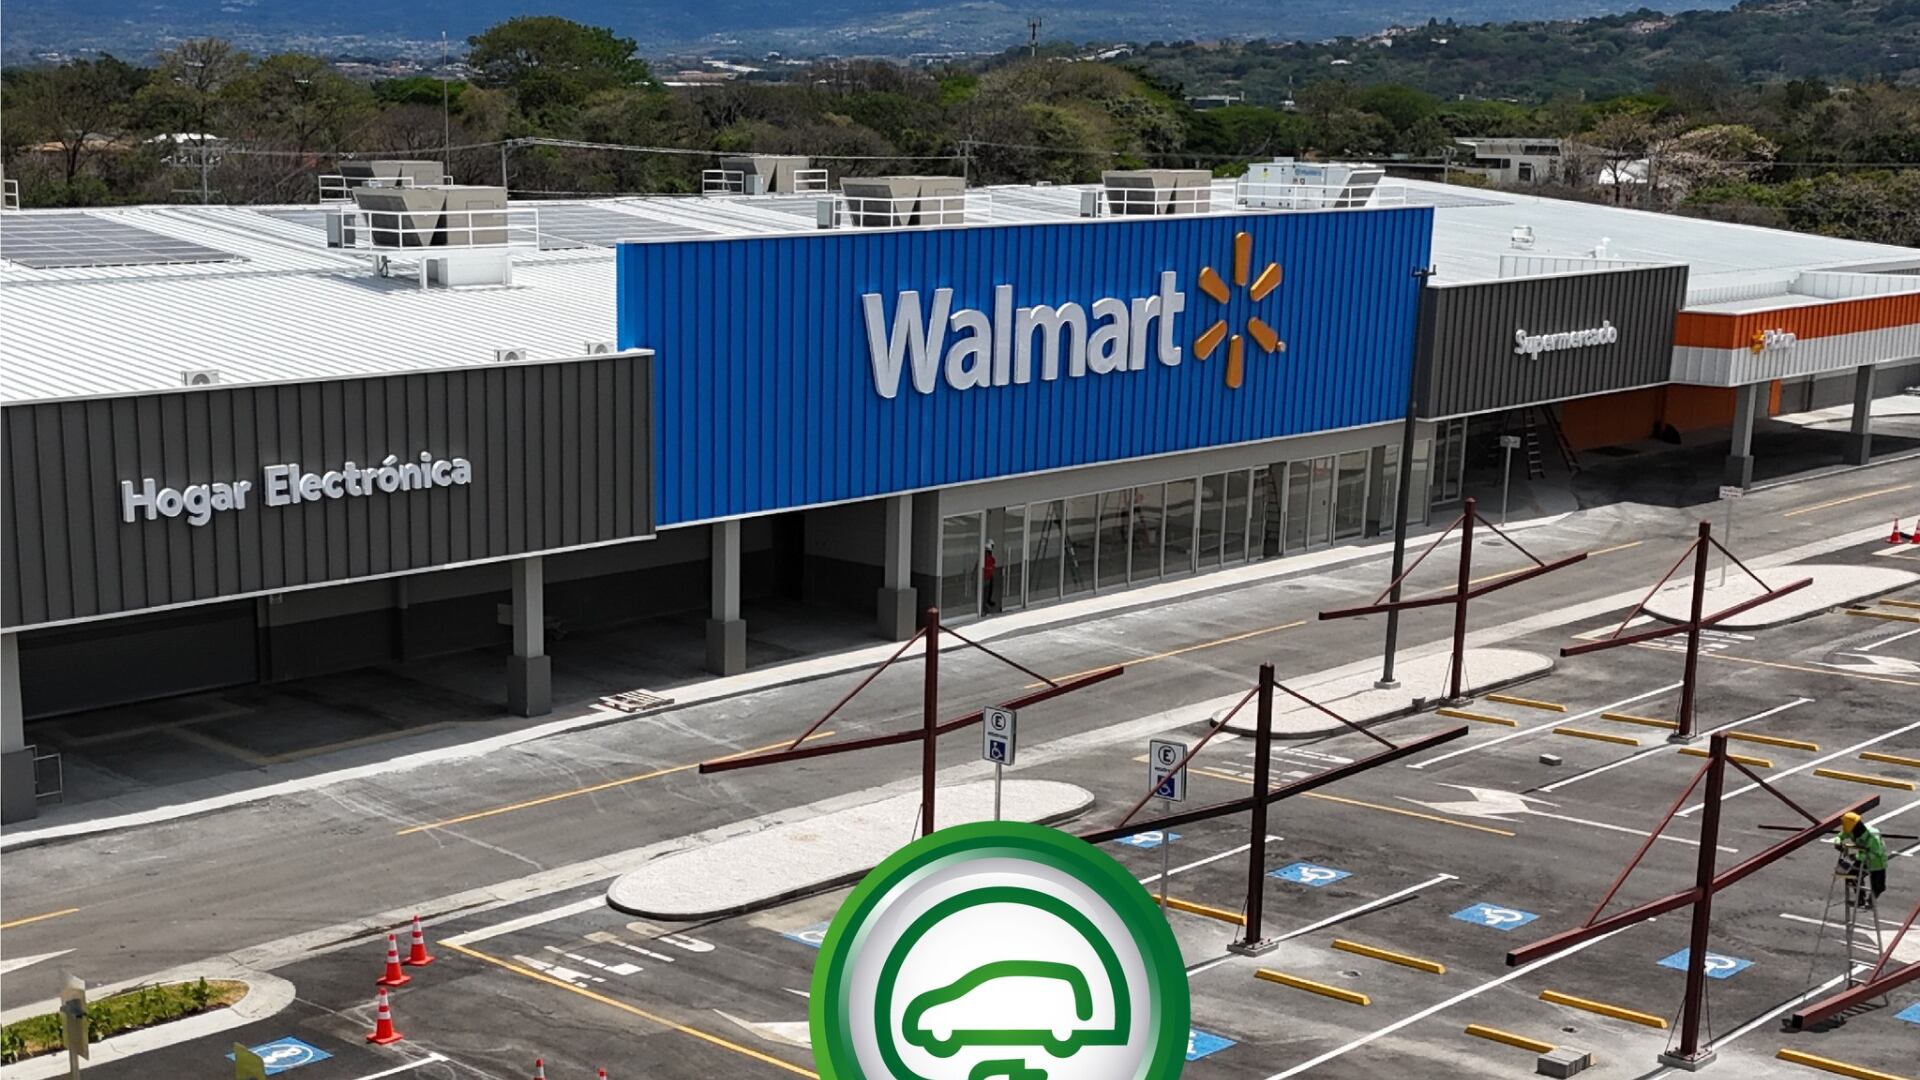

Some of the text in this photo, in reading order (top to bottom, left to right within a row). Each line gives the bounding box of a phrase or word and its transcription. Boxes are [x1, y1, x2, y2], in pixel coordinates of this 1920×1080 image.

[862, 271, 1186, 399] Walmart
[1514, 320, 1617, 360] Supermercado
[121, 451, 472, 527] Hogar Electrónica
